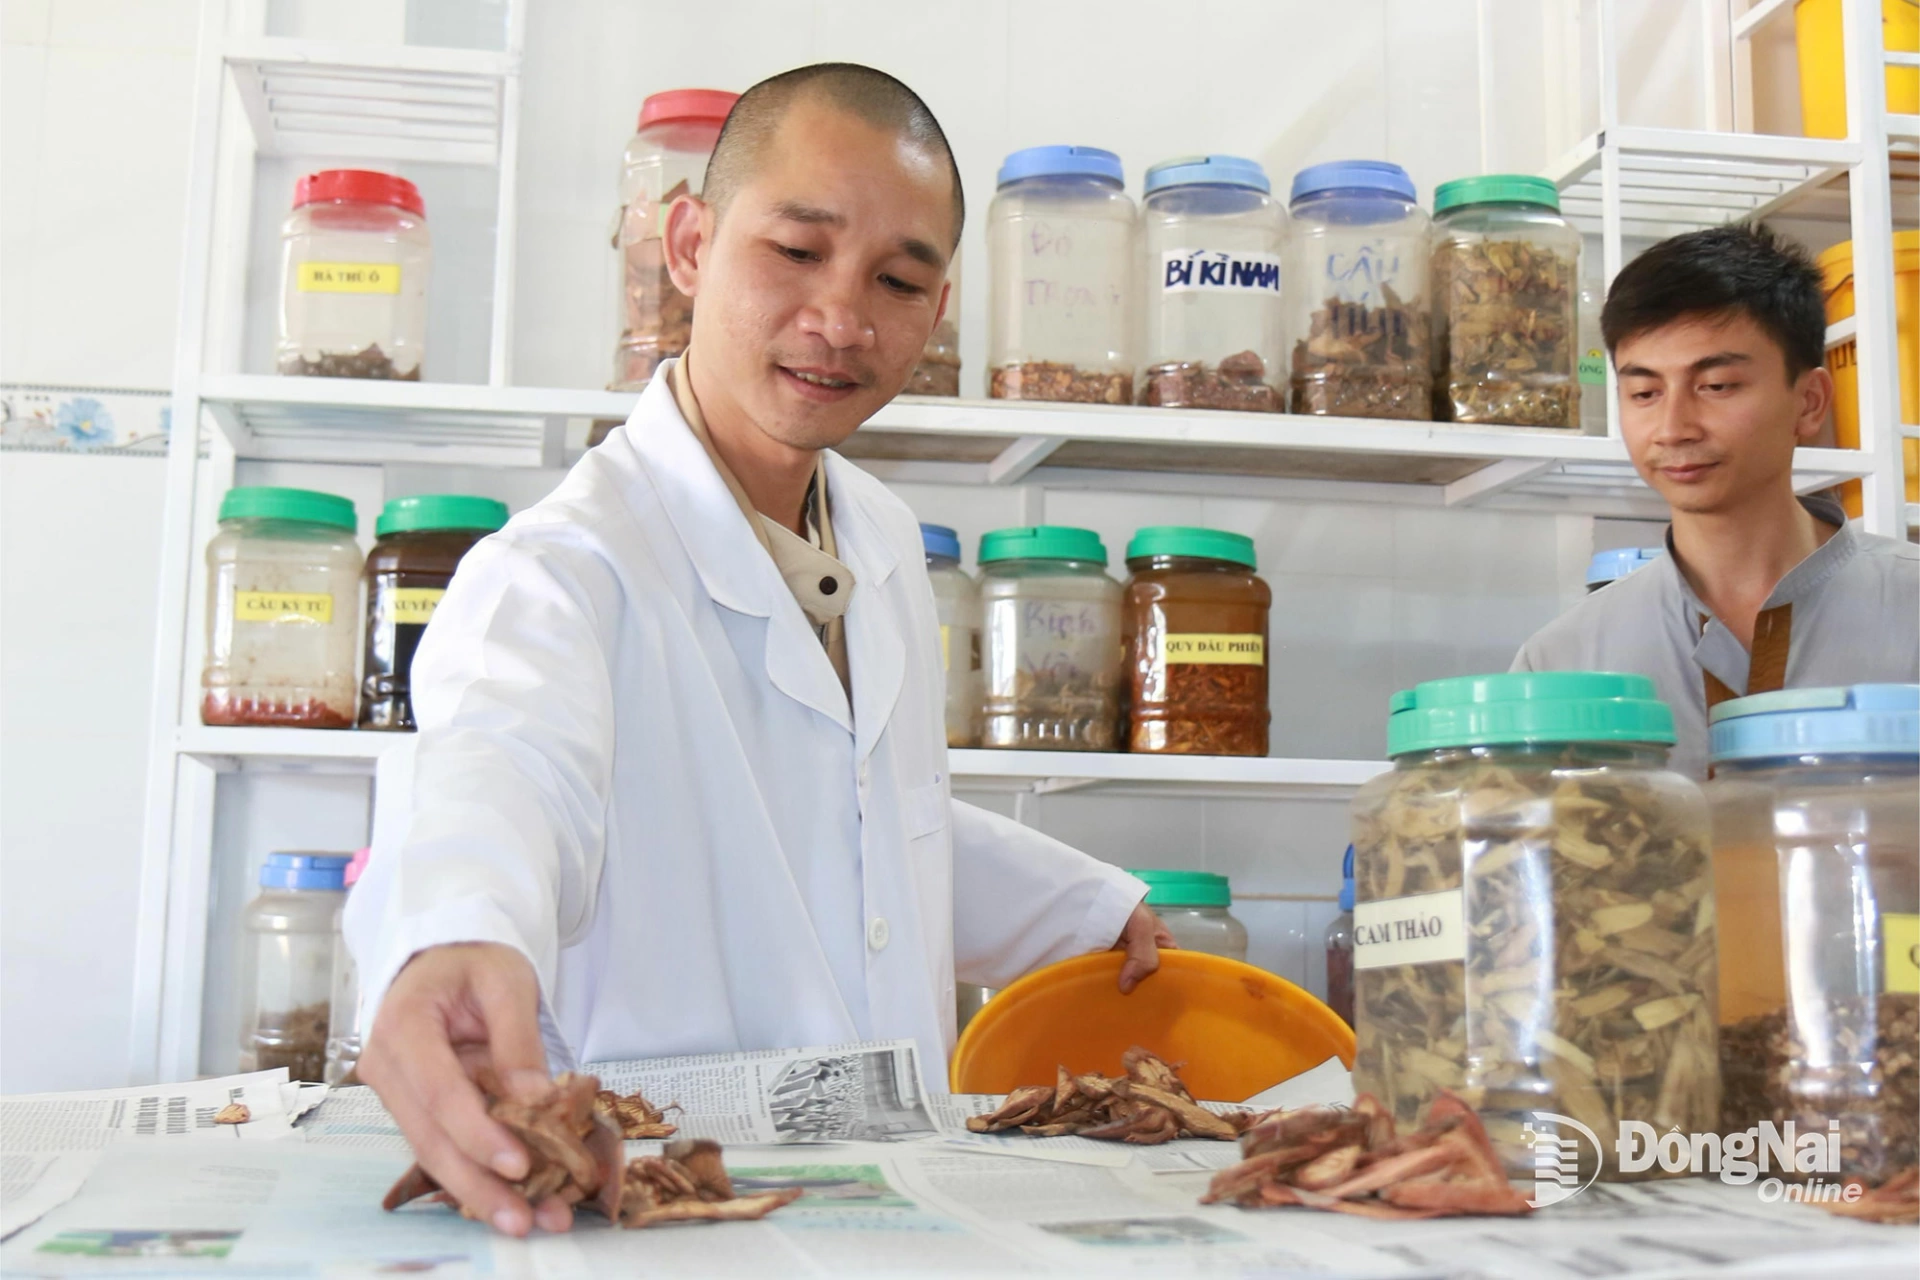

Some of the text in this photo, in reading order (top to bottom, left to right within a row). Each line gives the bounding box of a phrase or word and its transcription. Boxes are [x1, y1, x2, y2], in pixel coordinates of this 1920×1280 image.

[1165, 249, 1280, 292] BÍ KÌ NAM
[1166, 640, 1194, 653] QUY
[1354, 922, 1391, 946] CAM
